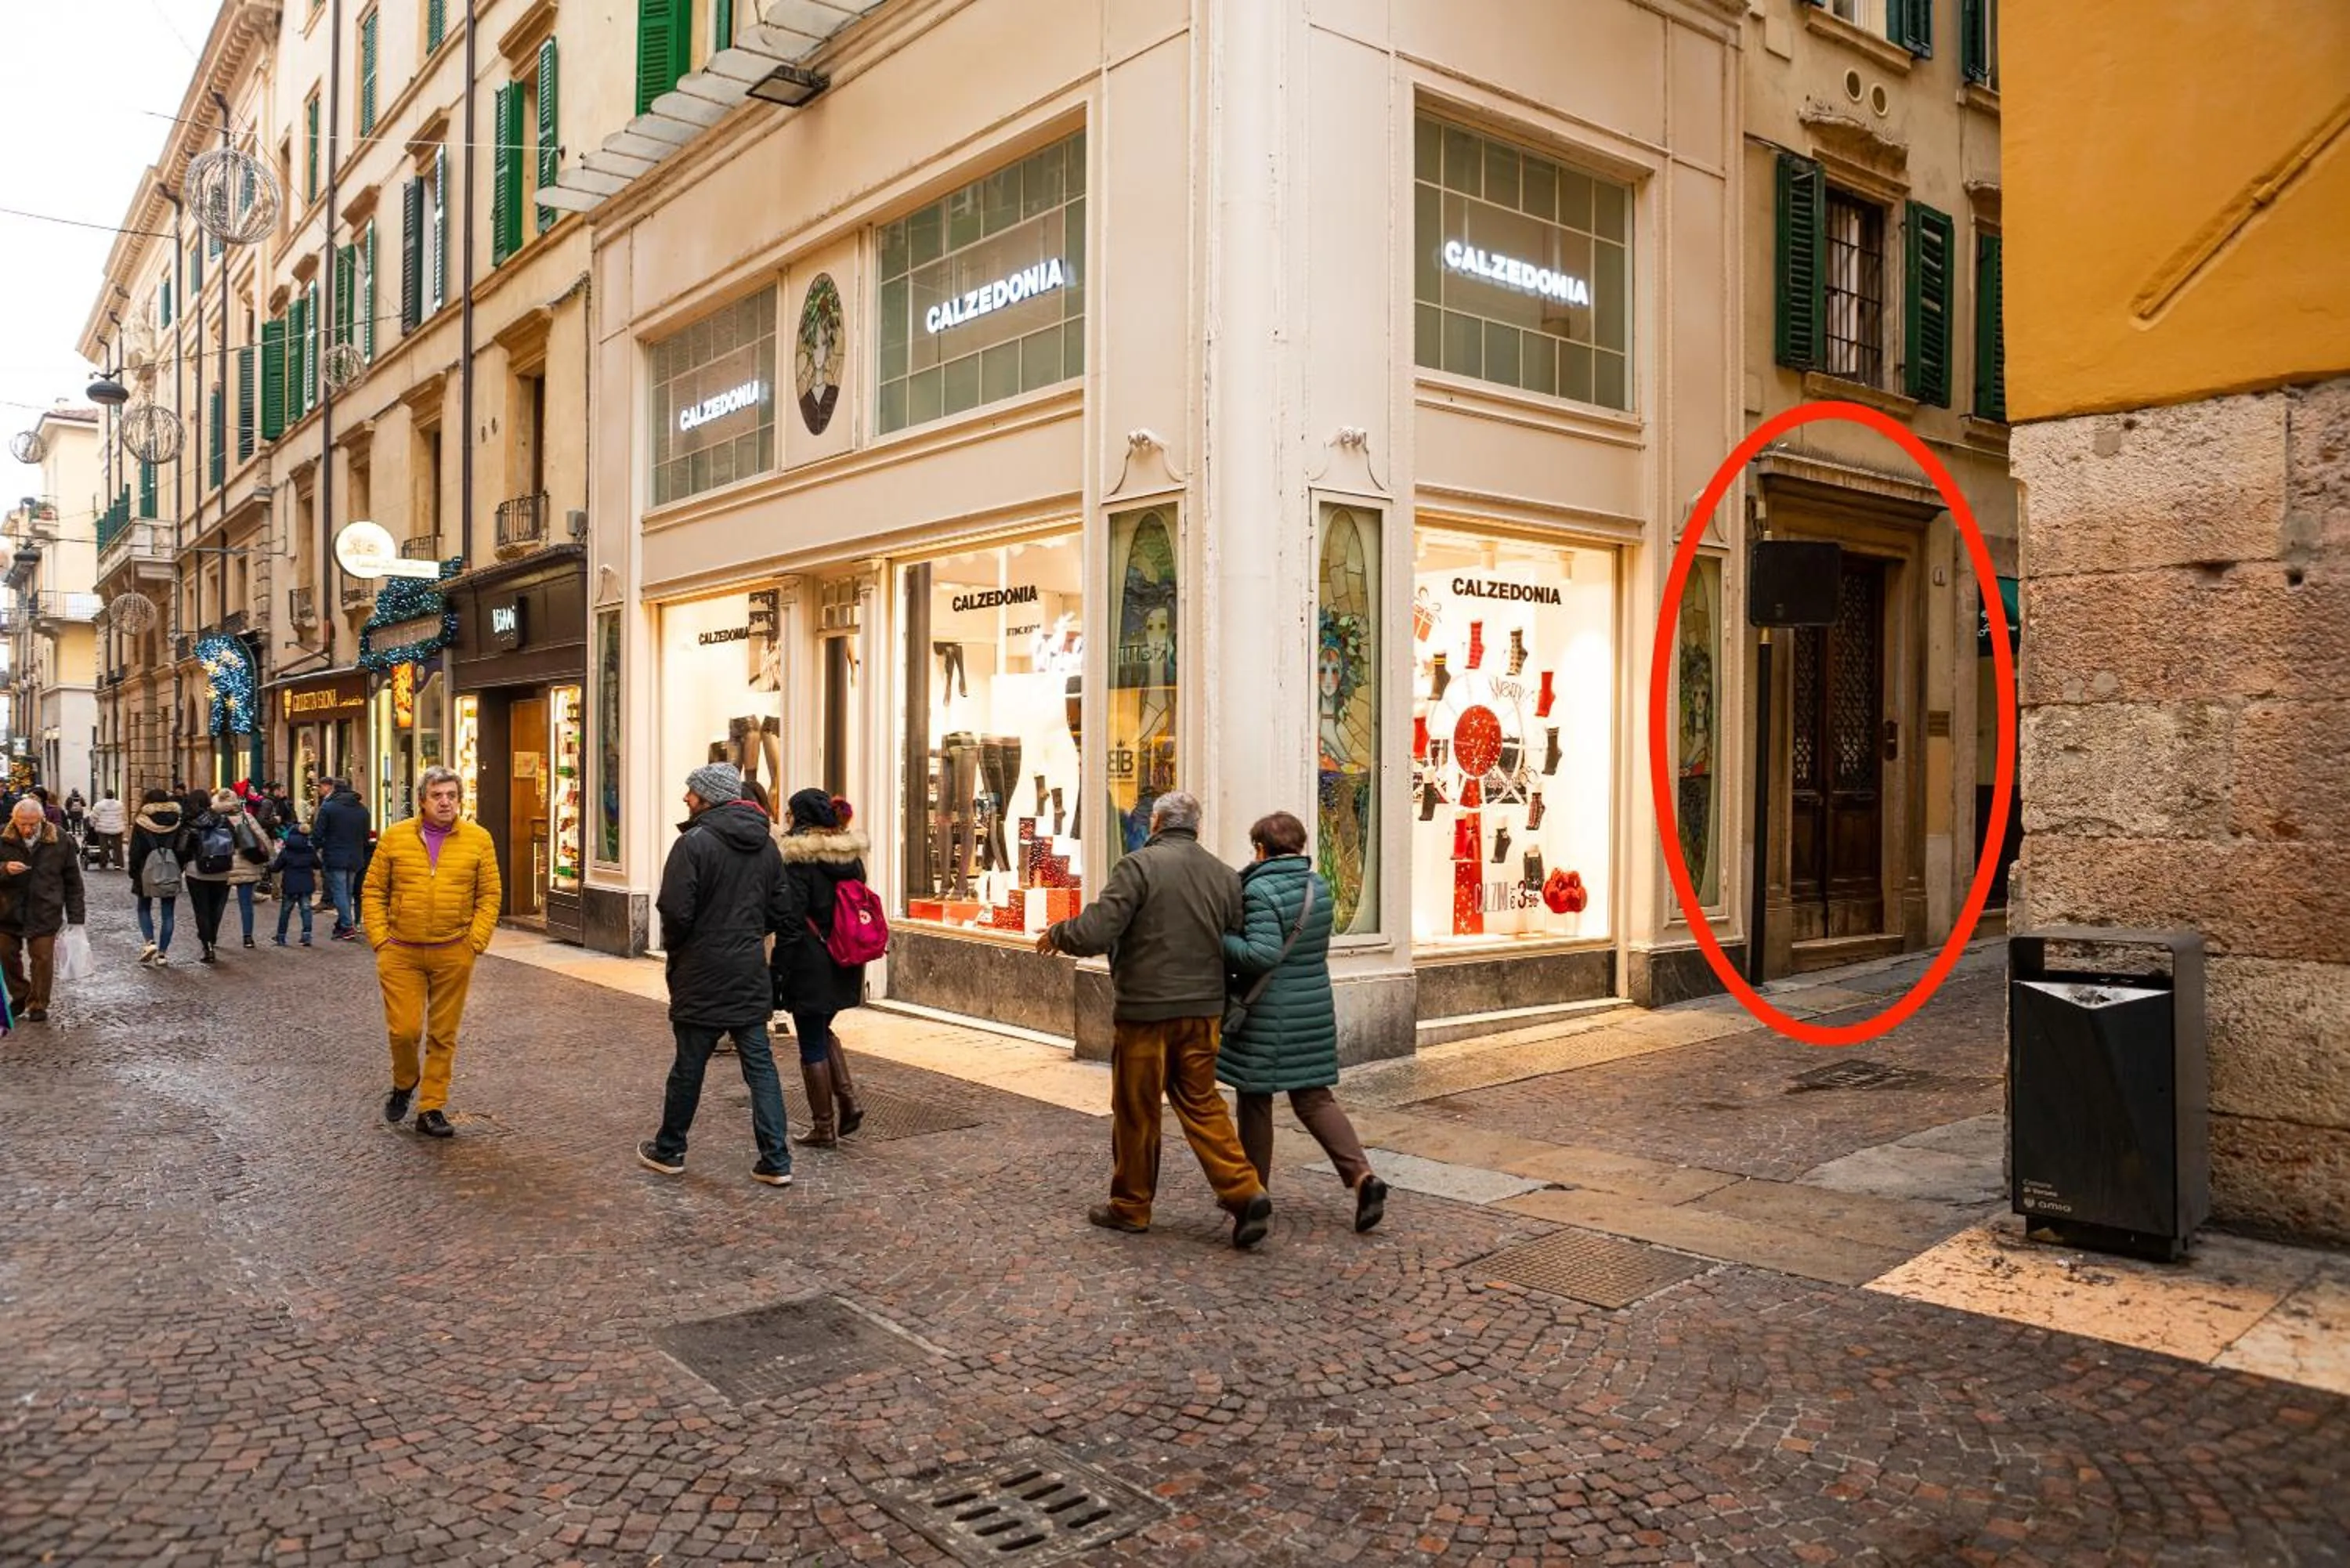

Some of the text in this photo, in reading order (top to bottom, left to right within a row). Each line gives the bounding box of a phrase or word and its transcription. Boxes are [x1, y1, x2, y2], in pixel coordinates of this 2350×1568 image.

[1444, 240, 1589, 305] CALZEDONIA
[926, 258, 1065, 334] CALZEDONIA
[680, 380, 758, 432] CALZEDONIA
[953, 585, 1038, 612] CALZEDONIA
[1452, 577, 1562, 605] CALZEDONIA
[699, 626, 750, 645] CALZEDONIA
